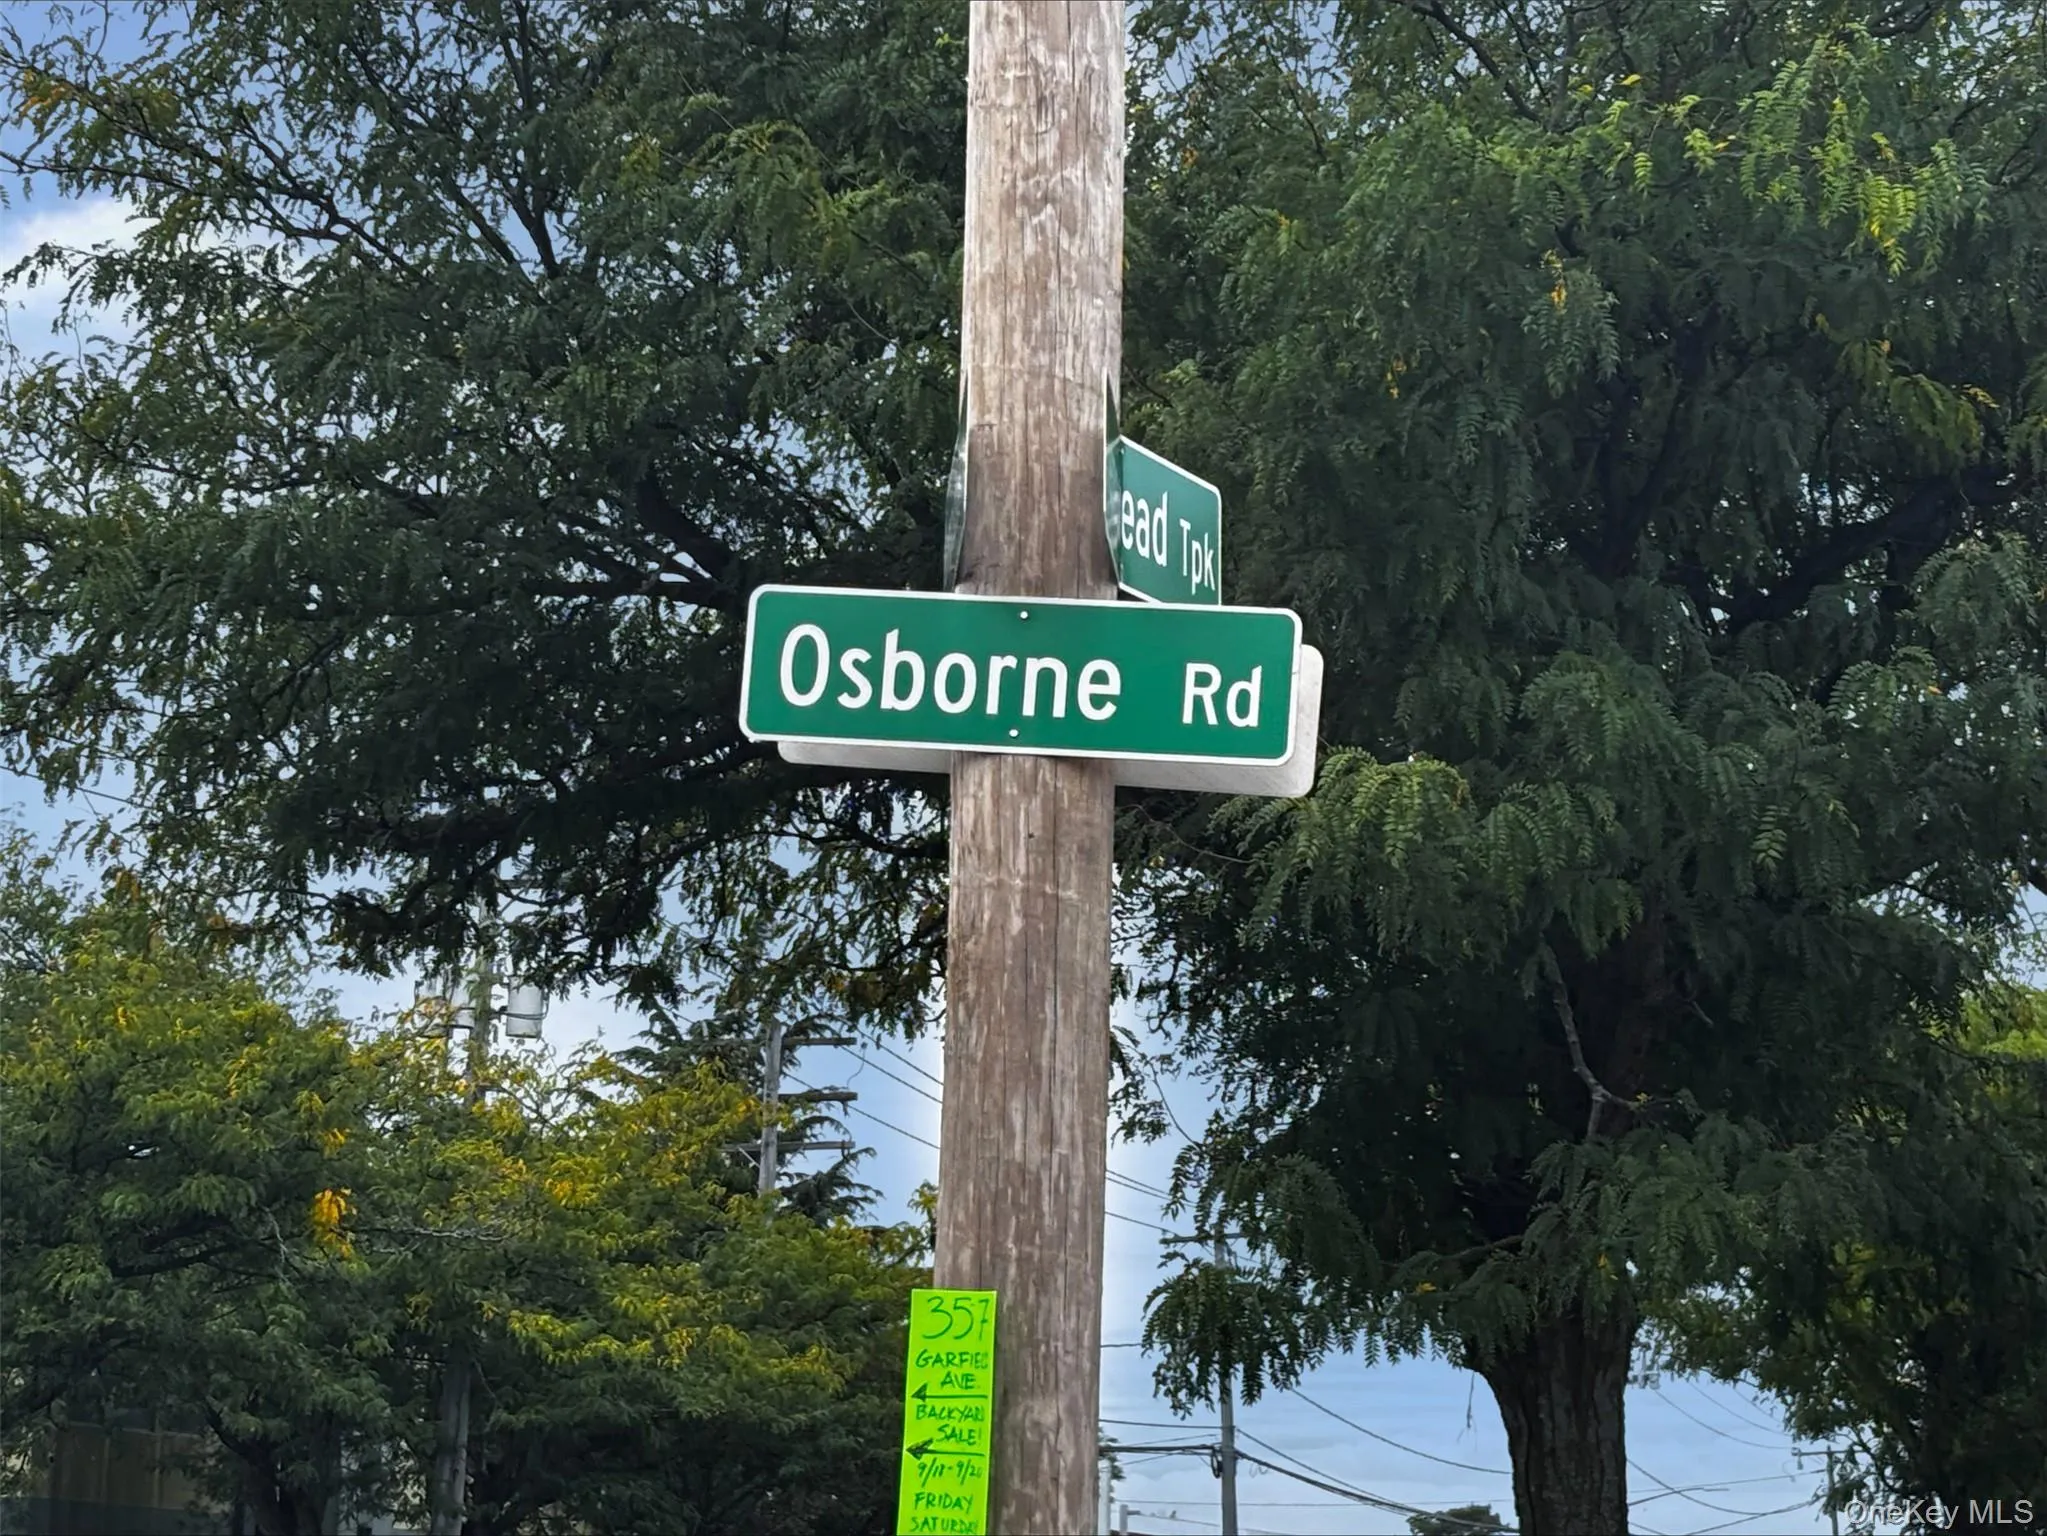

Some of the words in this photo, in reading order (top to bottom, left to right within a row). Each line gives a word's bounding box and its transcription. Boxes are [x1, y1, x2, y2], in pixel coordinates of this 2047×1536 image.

[1121, 490, 1168, 567] ead
[1179, 518, 1216, 595] Tpk
[780, 623, 1121, 721] Osborne
[1181, 662, 1262, 728] Rd
[921, 1296, 990, 1341] 357
[914, 1491, 974, 1514] FRIDAY
